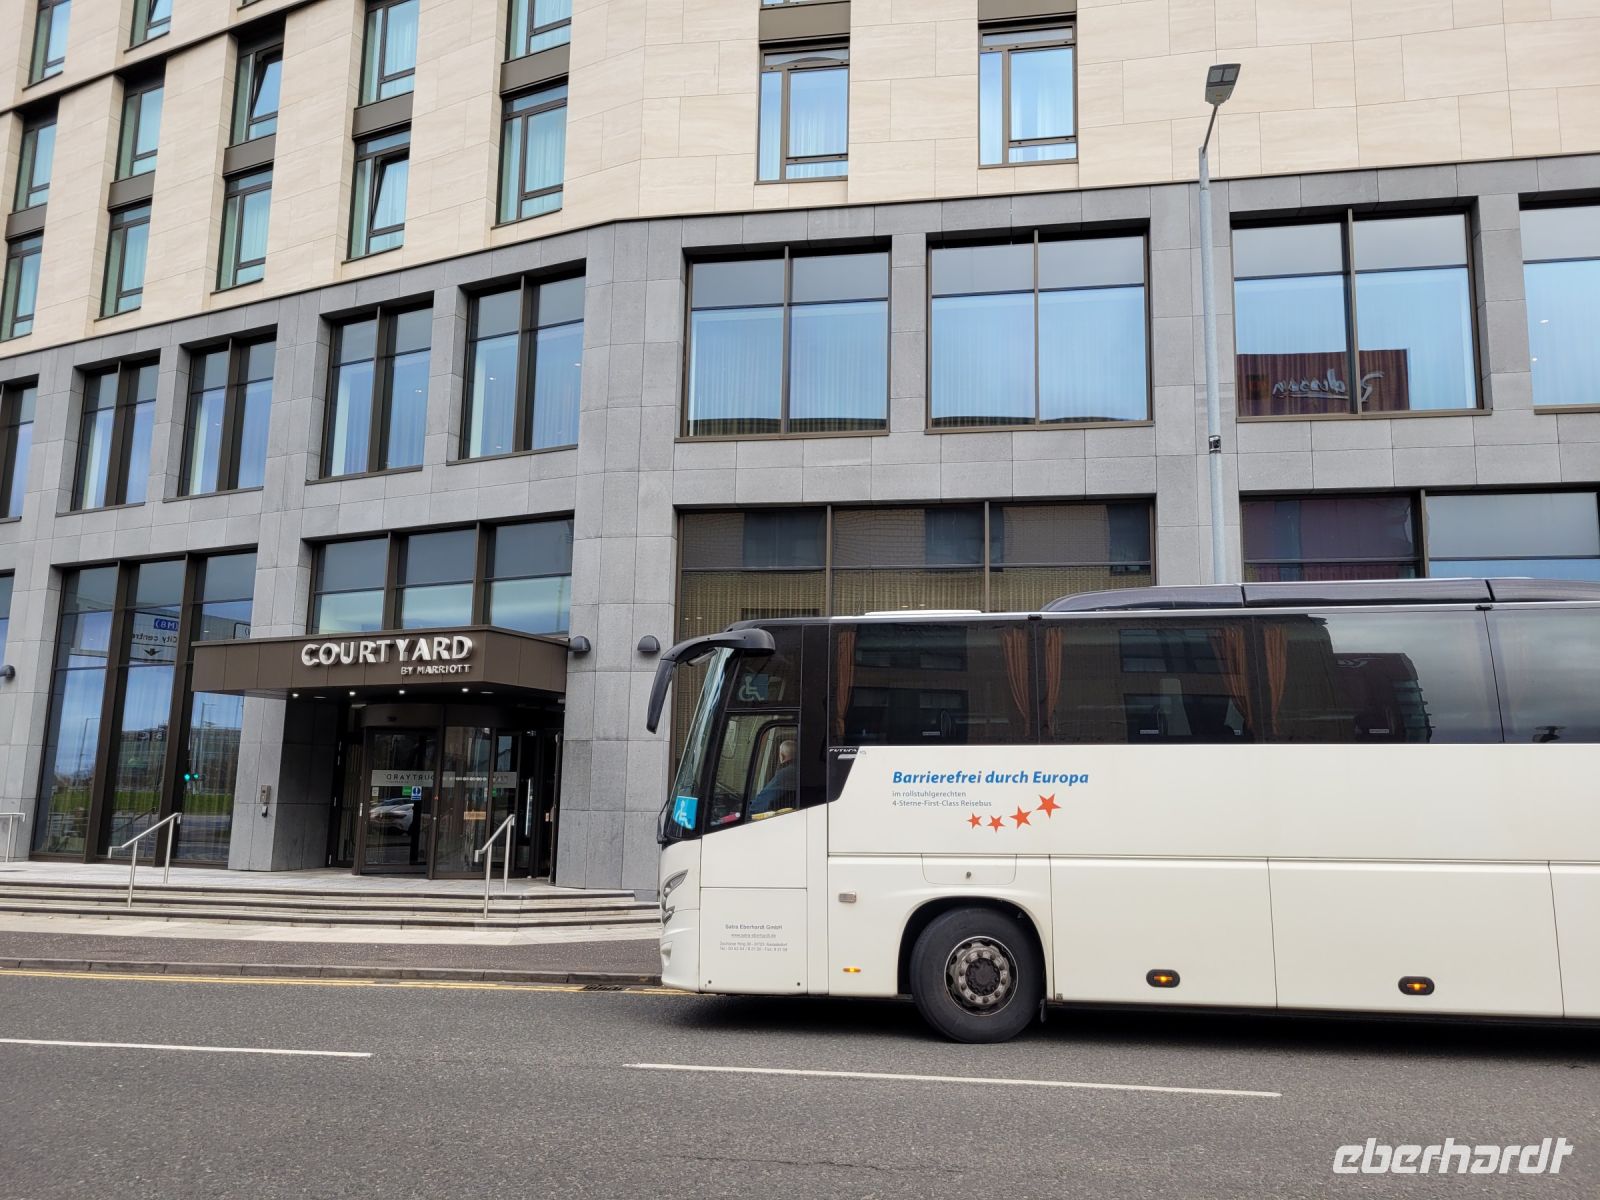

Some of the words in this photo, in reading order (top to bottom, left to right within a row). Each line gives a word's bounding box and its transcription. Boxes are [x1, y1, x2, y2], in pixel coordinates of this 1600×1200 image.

[301, 635, 473, 667] COURTYARD
[401, 666, 413, 675] BY
[417, 664, 471, 675] MARRIOTT
[892, 771, 981, 784] Barrierefrei
[985, 771, 1029, 784] durch
[1032, 771, 1089, 786] Europa
[902, 790, 966, 798] rollstuhlgerechten
